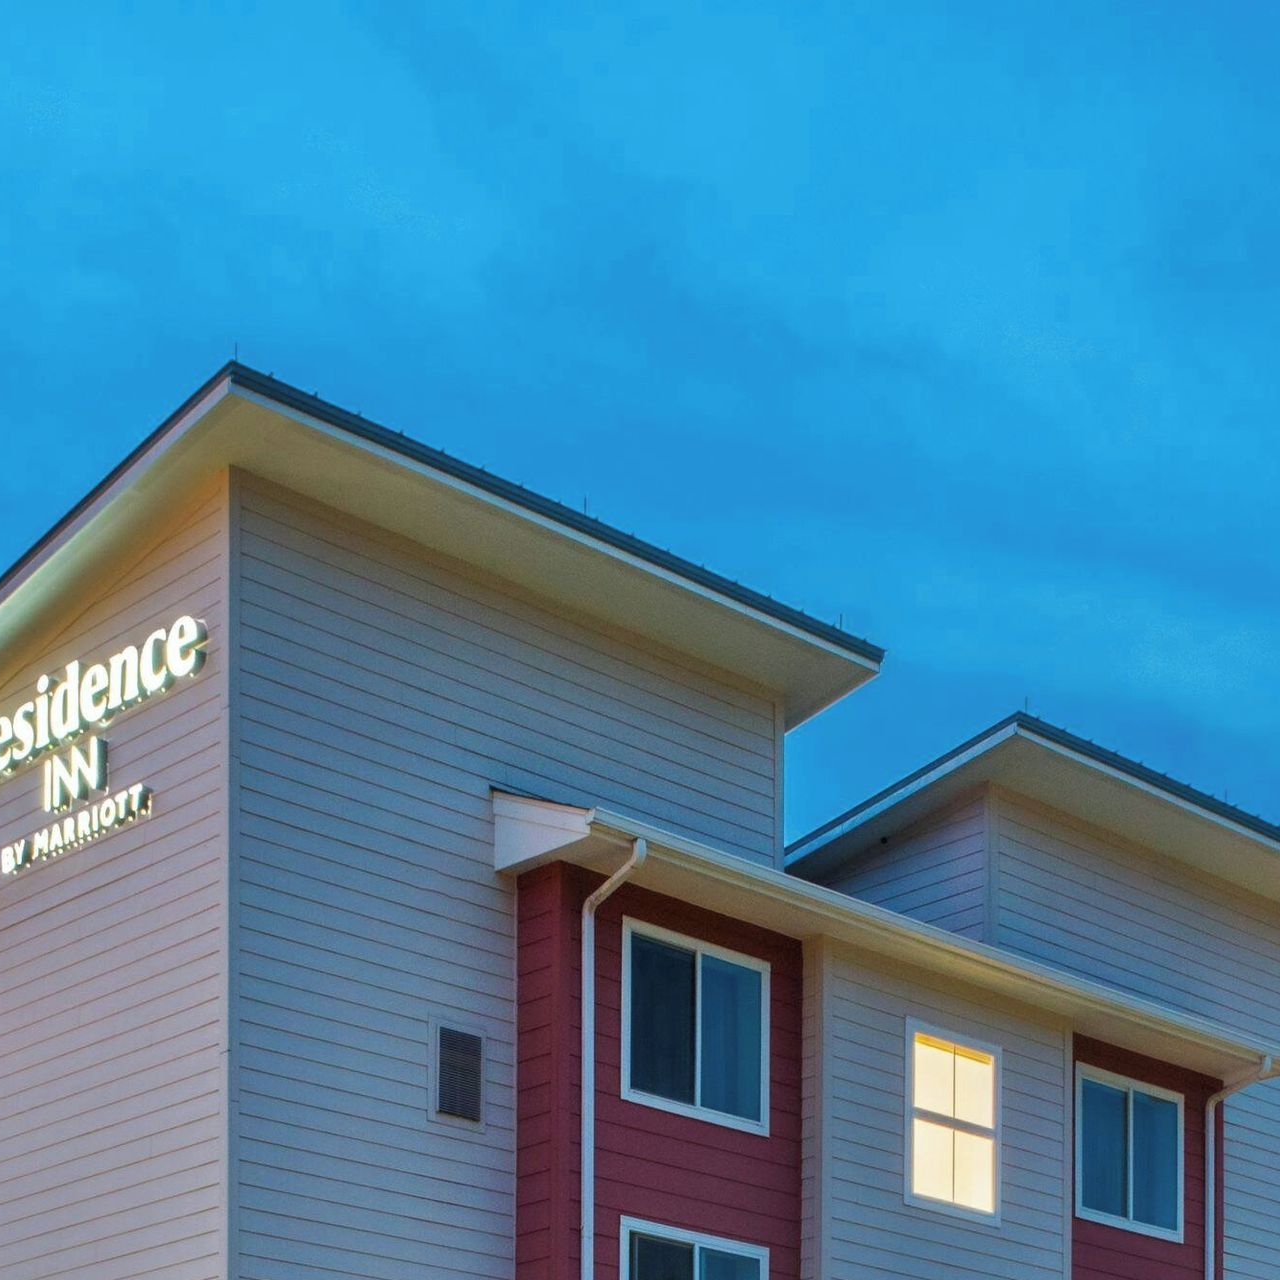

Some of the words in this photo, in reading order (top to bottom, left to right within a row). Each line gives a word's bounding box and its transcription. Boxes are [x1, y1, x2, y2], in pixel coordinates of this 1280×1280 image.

[43, 735, 103, 812] INN
[1, 839, 27, 874] BY
[32, 783, 147, 860] MARRIOTT
